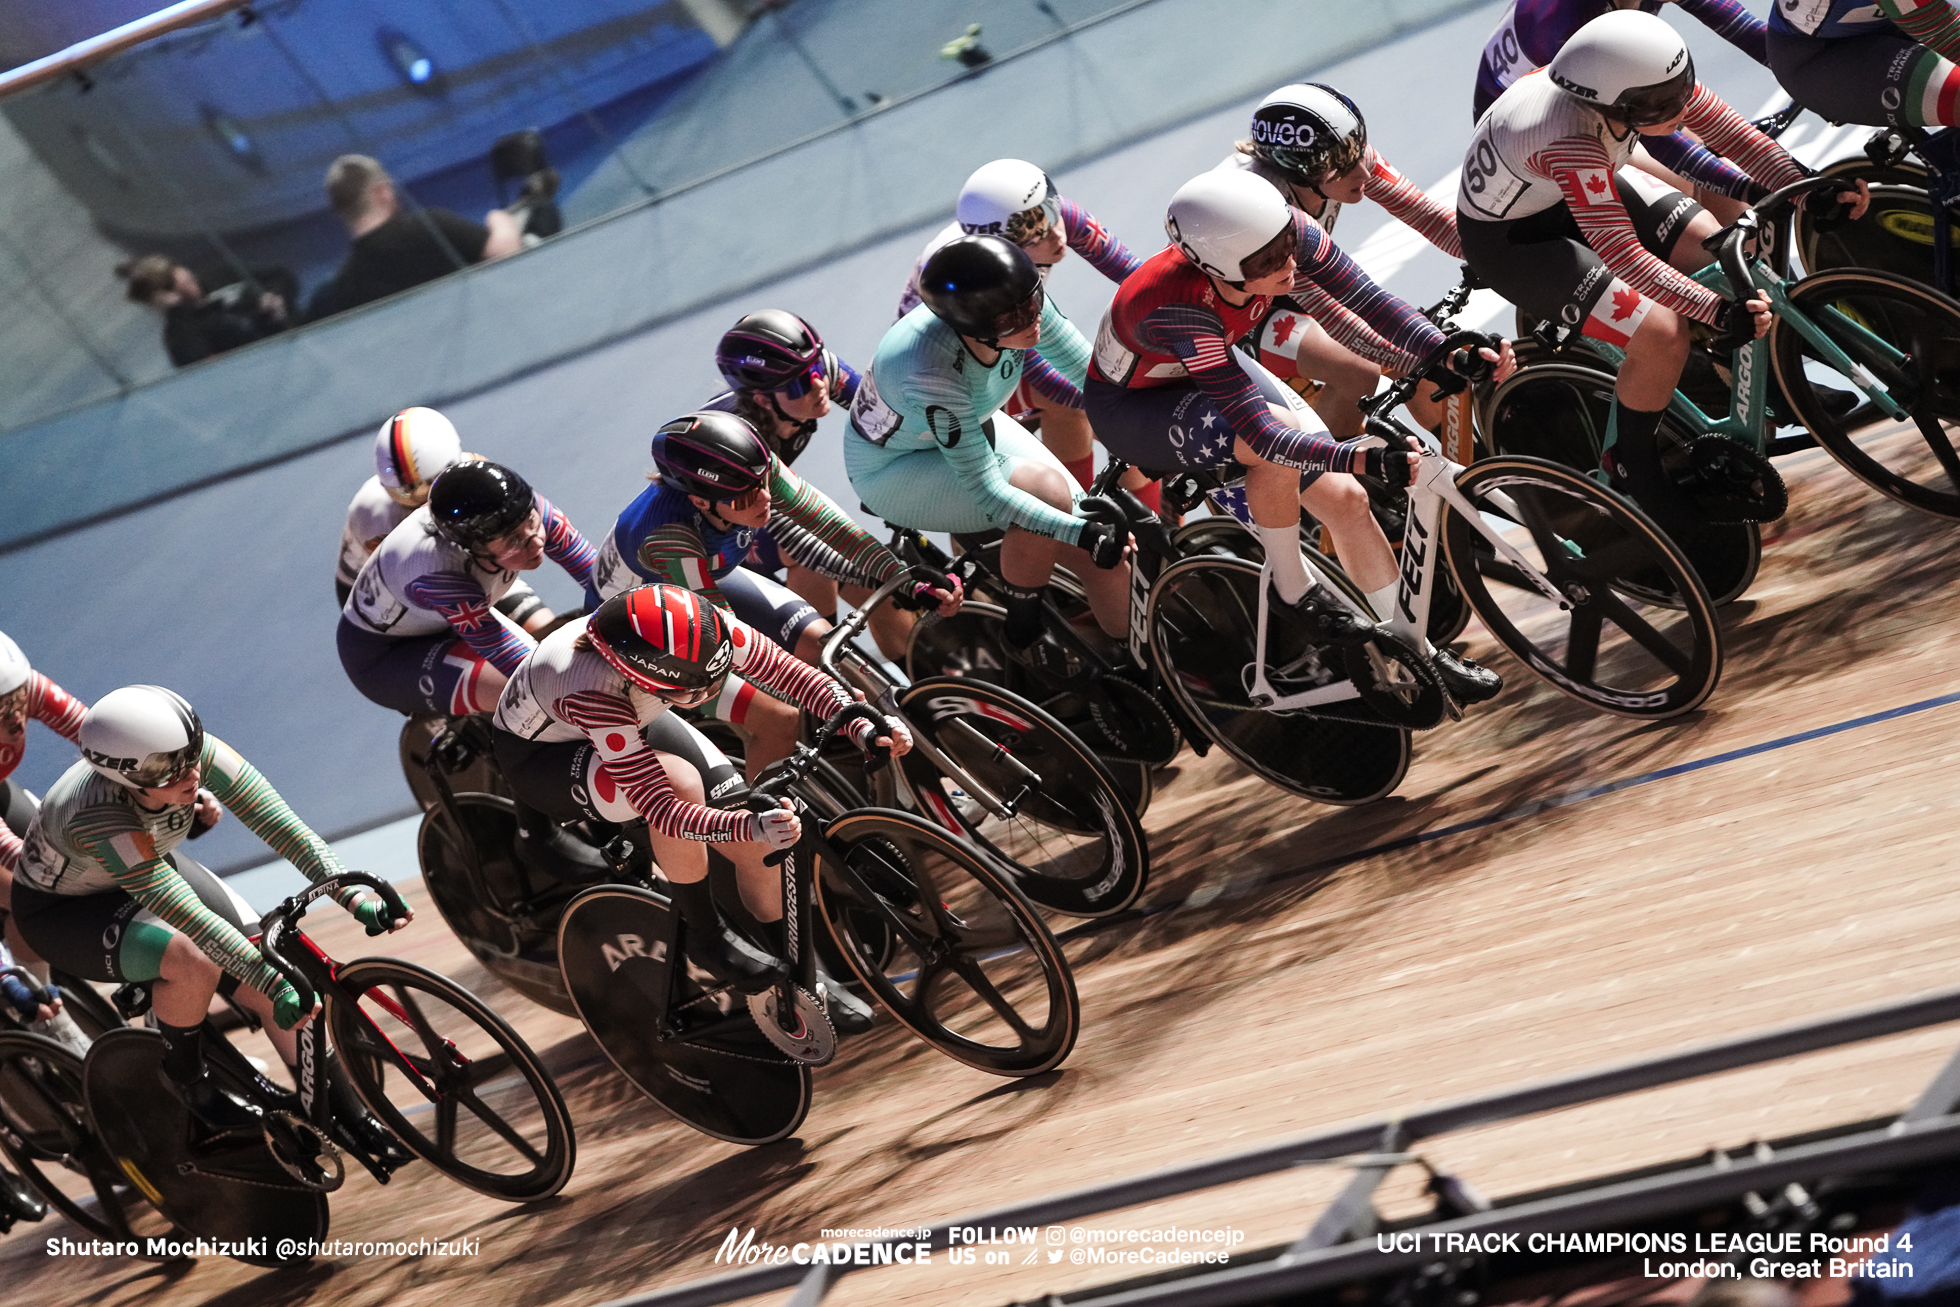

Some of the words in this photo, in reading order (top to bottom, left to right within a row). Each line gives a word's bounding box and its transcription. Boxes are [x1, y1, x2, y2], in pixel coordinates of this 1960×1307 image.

[1491, 27, 1519, 77] 40
[1550, 69, 1599, 100] LAZER
[1465, 138, 1498, 194] 50
[1678, 168, 1728, 197] Santini
[961, 220, 1004, 235] AZER
[1655, 195, 1698, 244] Santin
[1572, 263, 1599, 298] TRACK
[1653, 268, 1715, 305] Santini
[1350, 336, 1401, 364] Santini
[1446, 393, 1460, 457] RGON
[697, 467, 720, 482] LEM
[1271, 453, 1326, 473] Santini
[1398, 497, 1429, 624] FELT
[780, 603, 819, 642] Santin
[1129, 551, 1151, 671] FELT
[629, 653, 681, 679] JAPAN
[82, 746, 139, 771] AZER
[570, 743, 585, 778] TRACK
[683, 828, 733, 842] Santini
[201, 938, 257, 987] Santini
